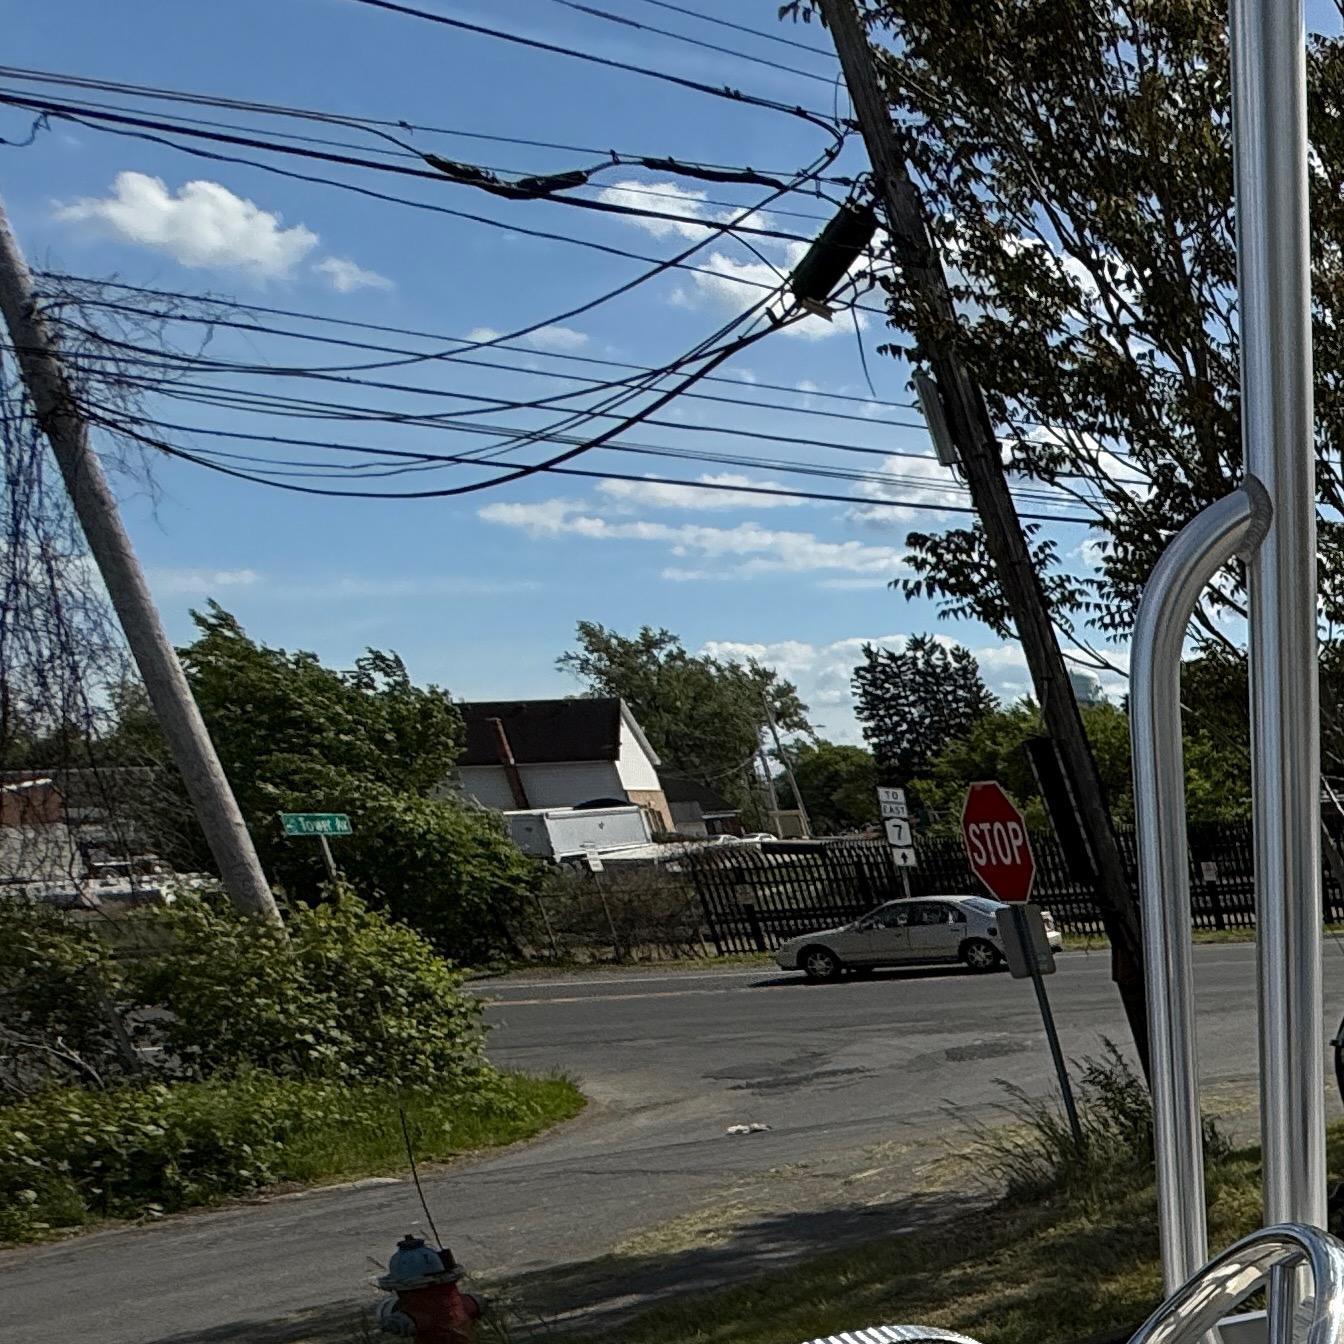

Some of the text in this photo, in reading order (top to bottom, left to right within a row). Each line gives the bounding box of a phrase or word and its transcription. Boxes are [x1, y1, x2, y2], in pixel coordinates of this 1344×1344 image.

[884, 791, 899, 801] TO
[882, 804, 906, 815] EAST
[892, 824, 902, 841] 7
[968, 821, 1024, 866] STOP
